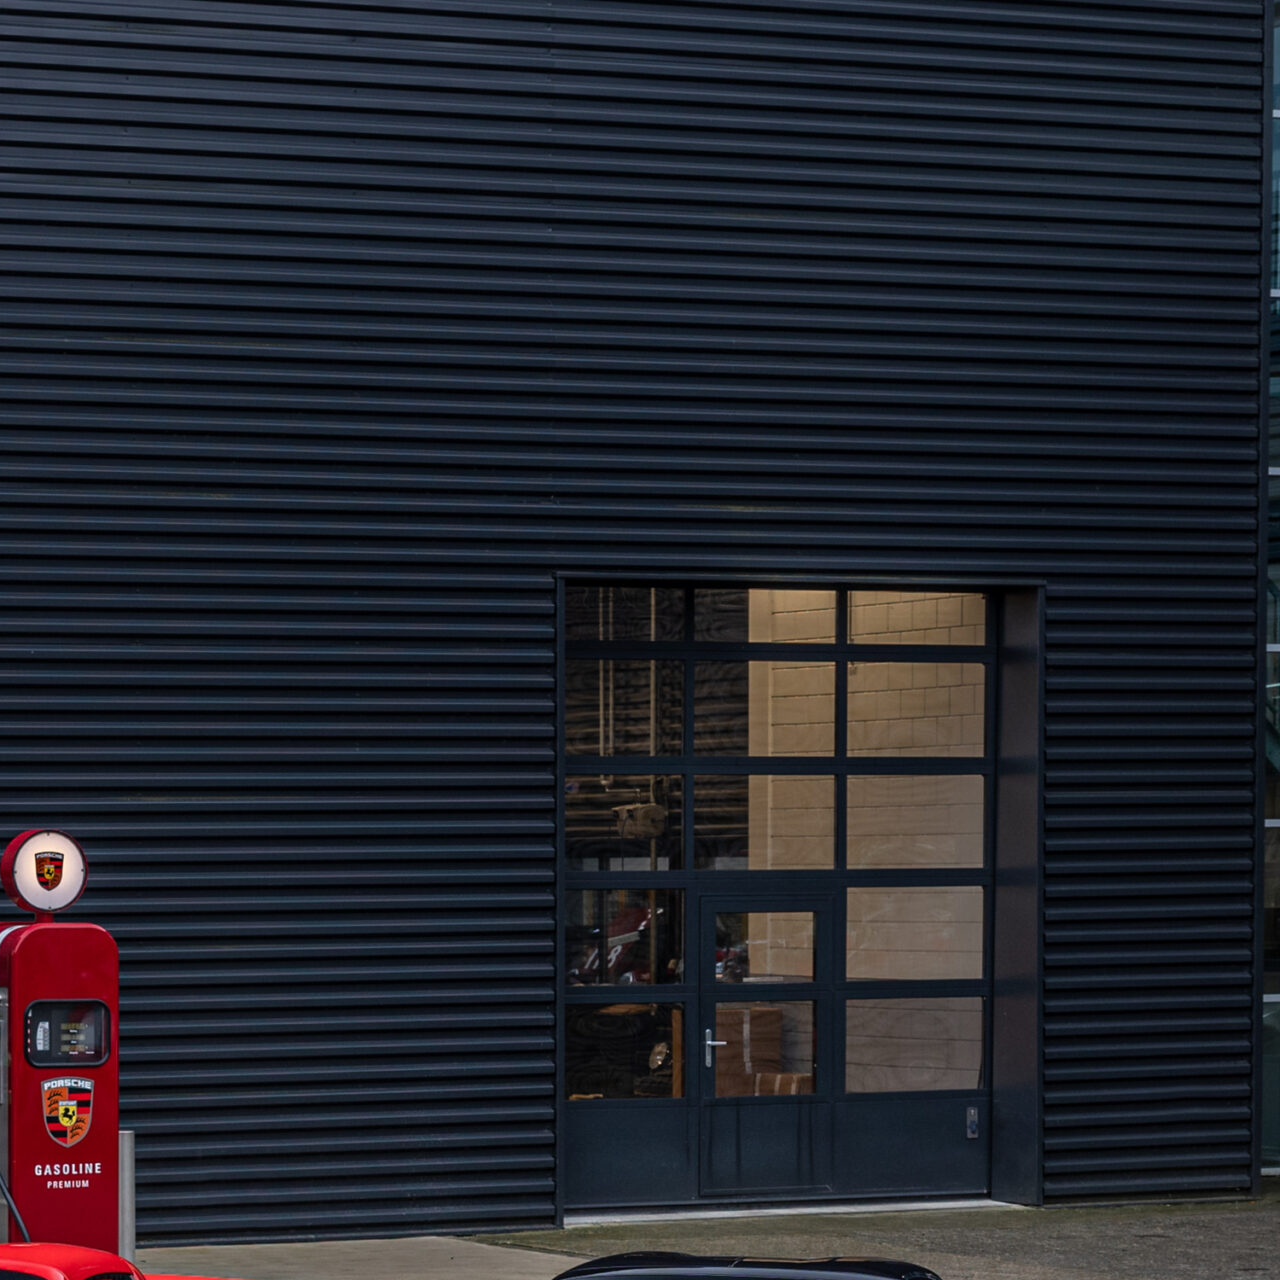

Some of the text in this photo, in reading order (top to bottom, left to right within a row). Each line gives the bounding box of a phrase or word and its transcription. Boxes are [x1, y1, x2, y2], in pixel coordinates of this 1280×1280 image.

[44, 1078, 92, 1090] PORSCHE
[34, 1162, 102, 1176] GASOLINE
[47, 1179, 89, 1189] PREMIUM
